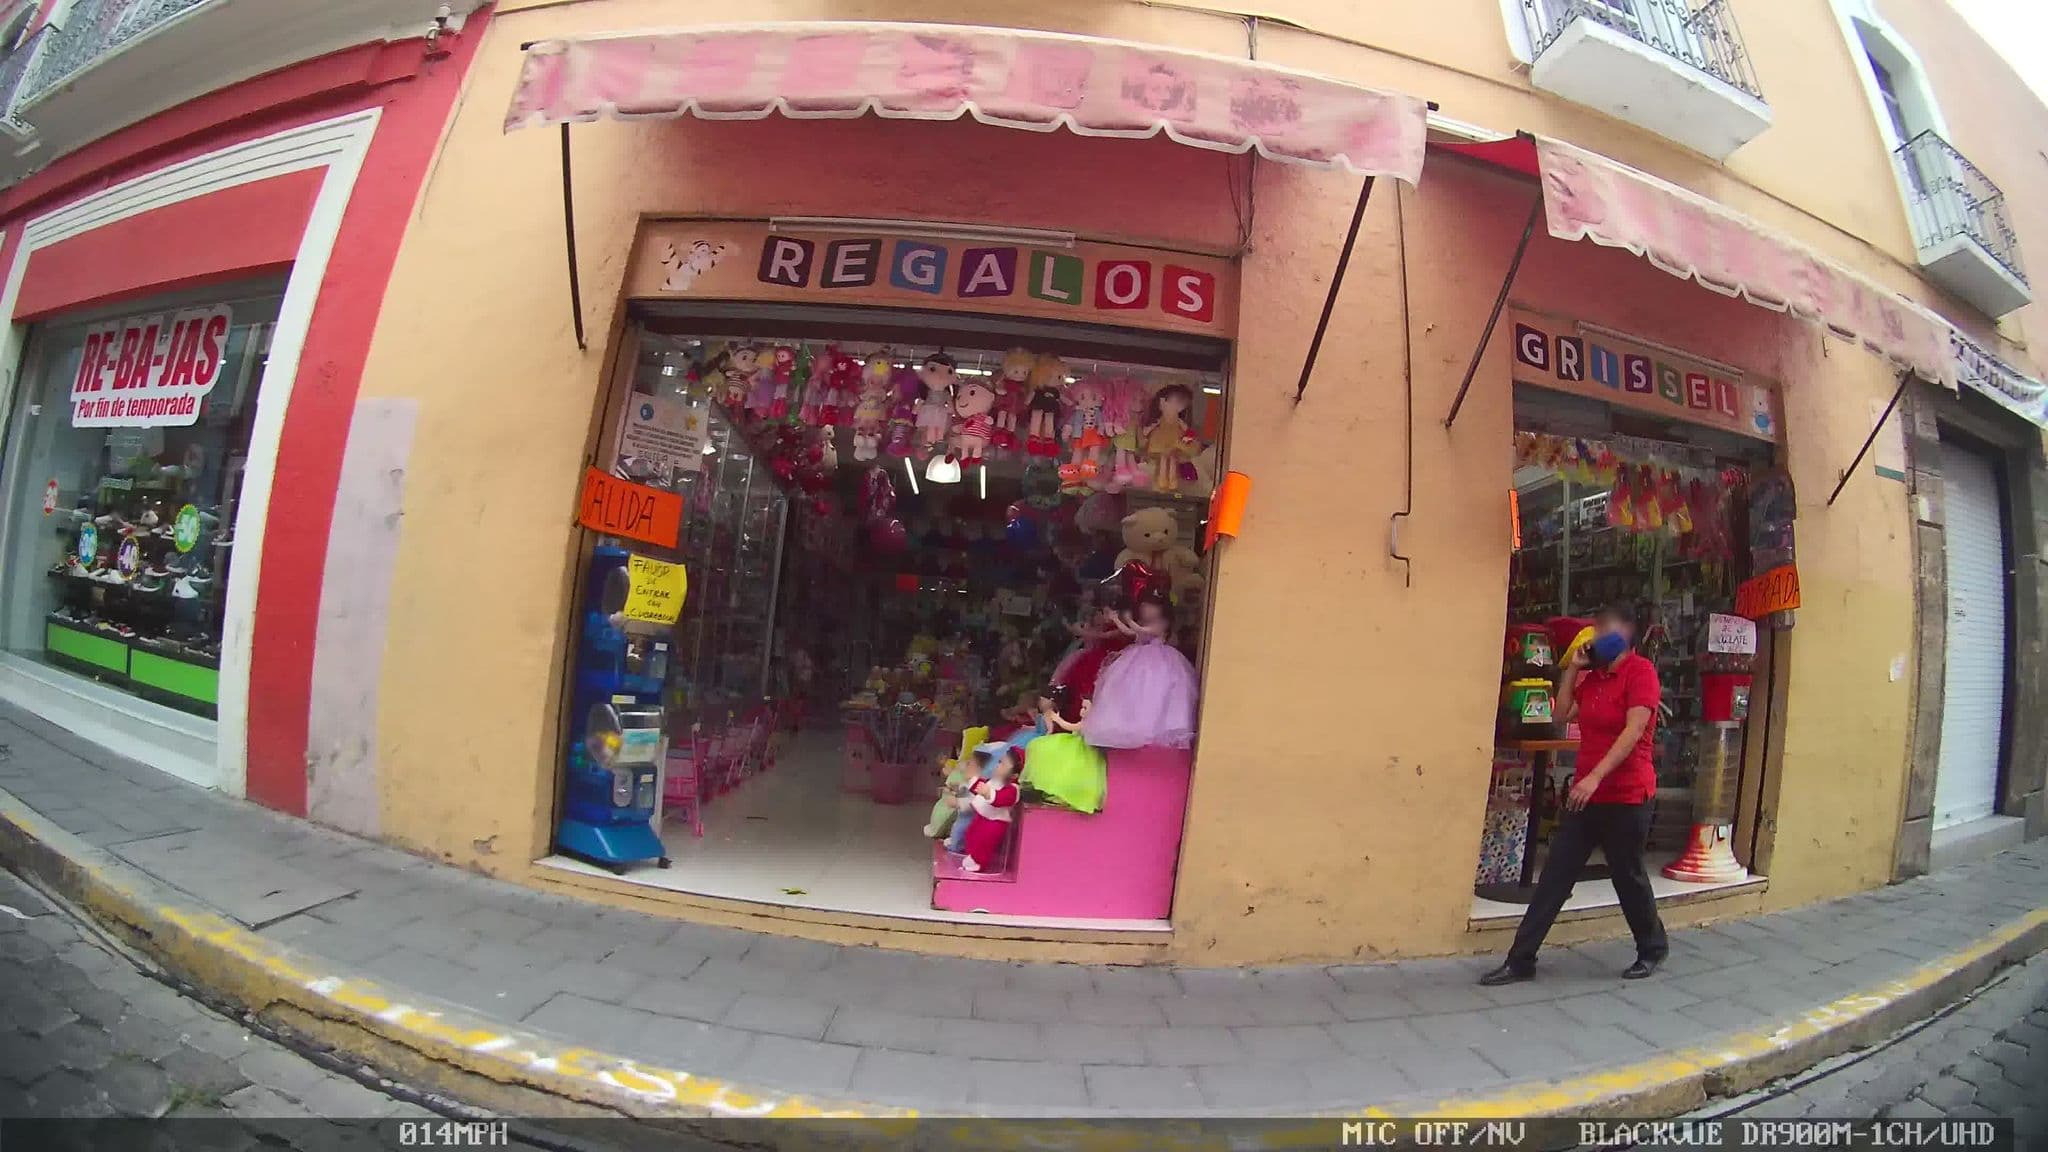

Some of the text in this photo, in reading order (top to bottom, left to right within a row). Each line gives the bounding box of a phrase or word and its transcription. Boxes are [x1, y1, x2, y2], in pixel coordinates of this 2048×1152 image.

[769, 240, 1204, 312] REGALOS
[75, 315, 227, 393] RE-BA-JAS
[1521, 333, 1735, 416] GRISSEL
[77, 392, 195, 419] Por fin de temporada
